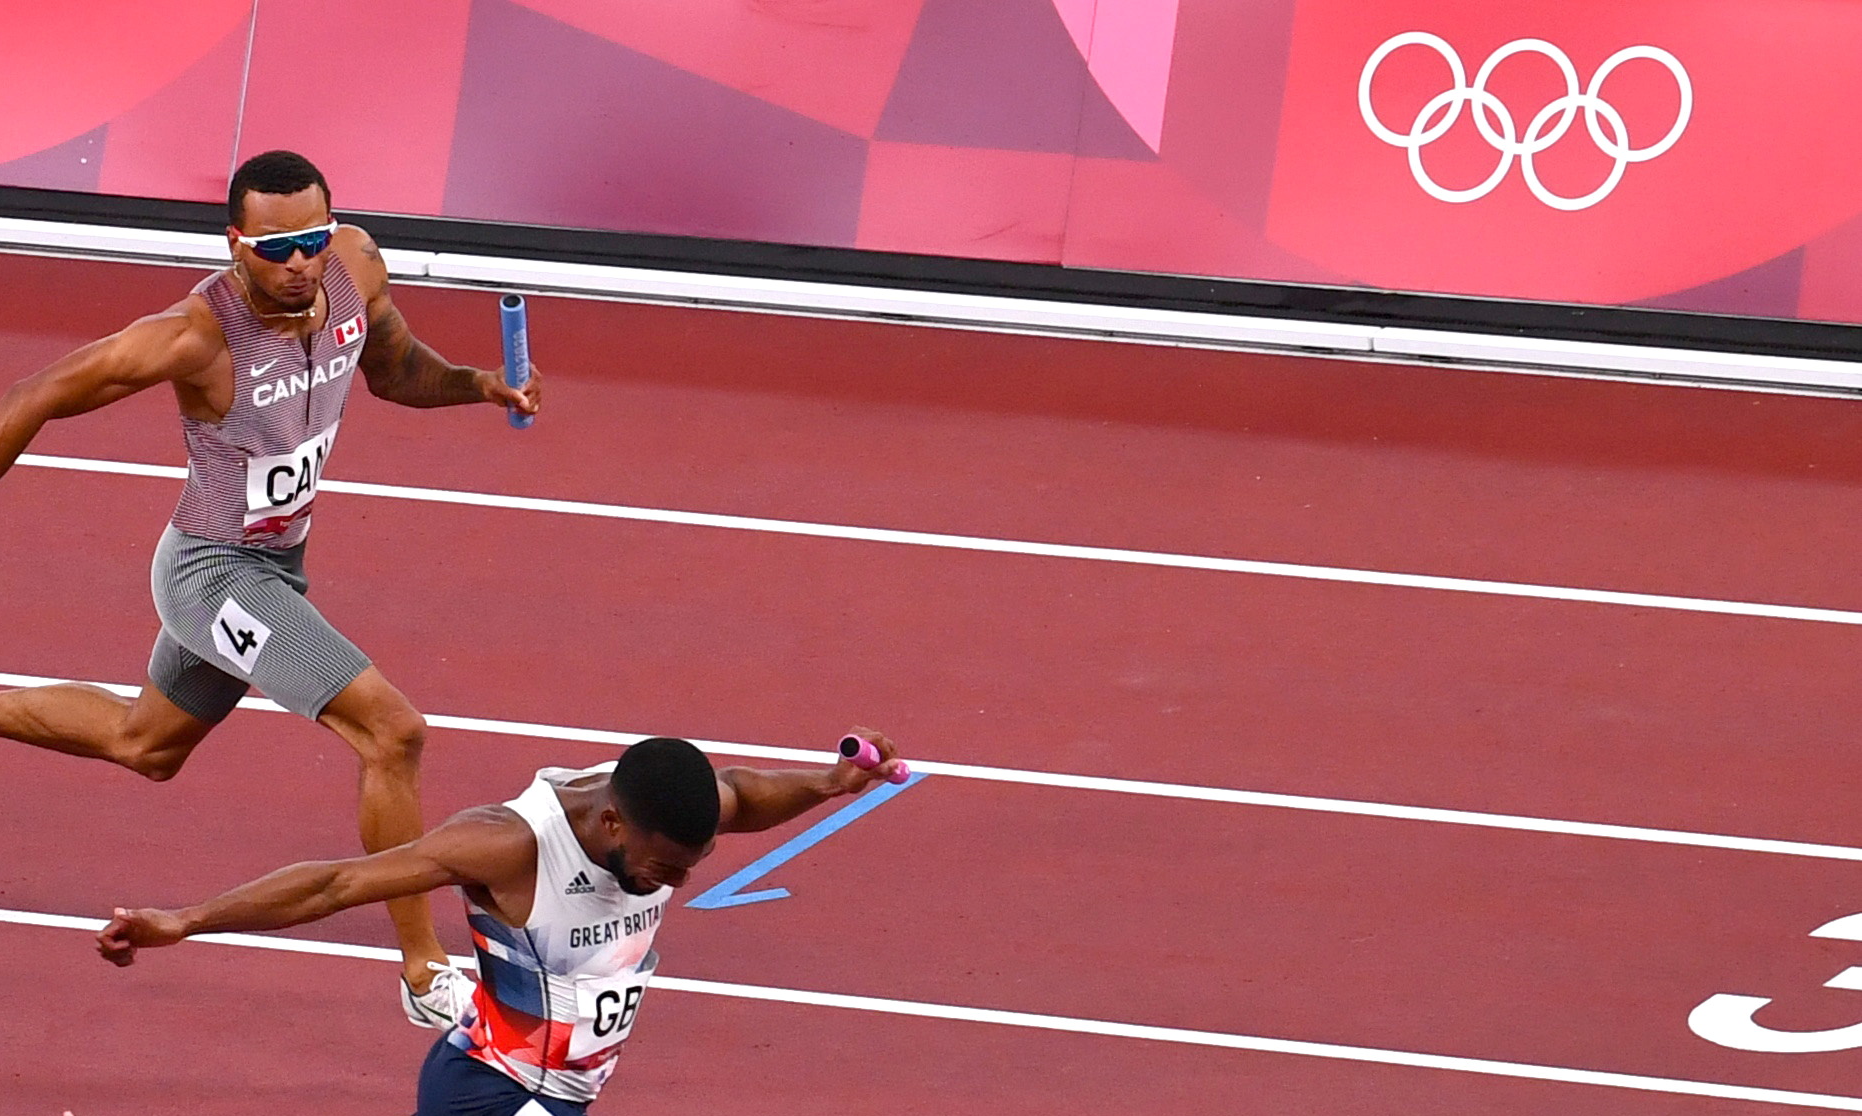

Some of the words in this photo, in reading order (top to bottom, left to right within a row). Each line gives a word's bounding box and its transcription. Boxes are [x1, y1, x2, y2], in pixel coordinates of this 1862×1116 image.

[252, 350, 359, 407] CANADA
[220, 617, 258, 656] 4
[564, 884, 596, 895] adidas
[570, 919, 620, 948] GREAT
